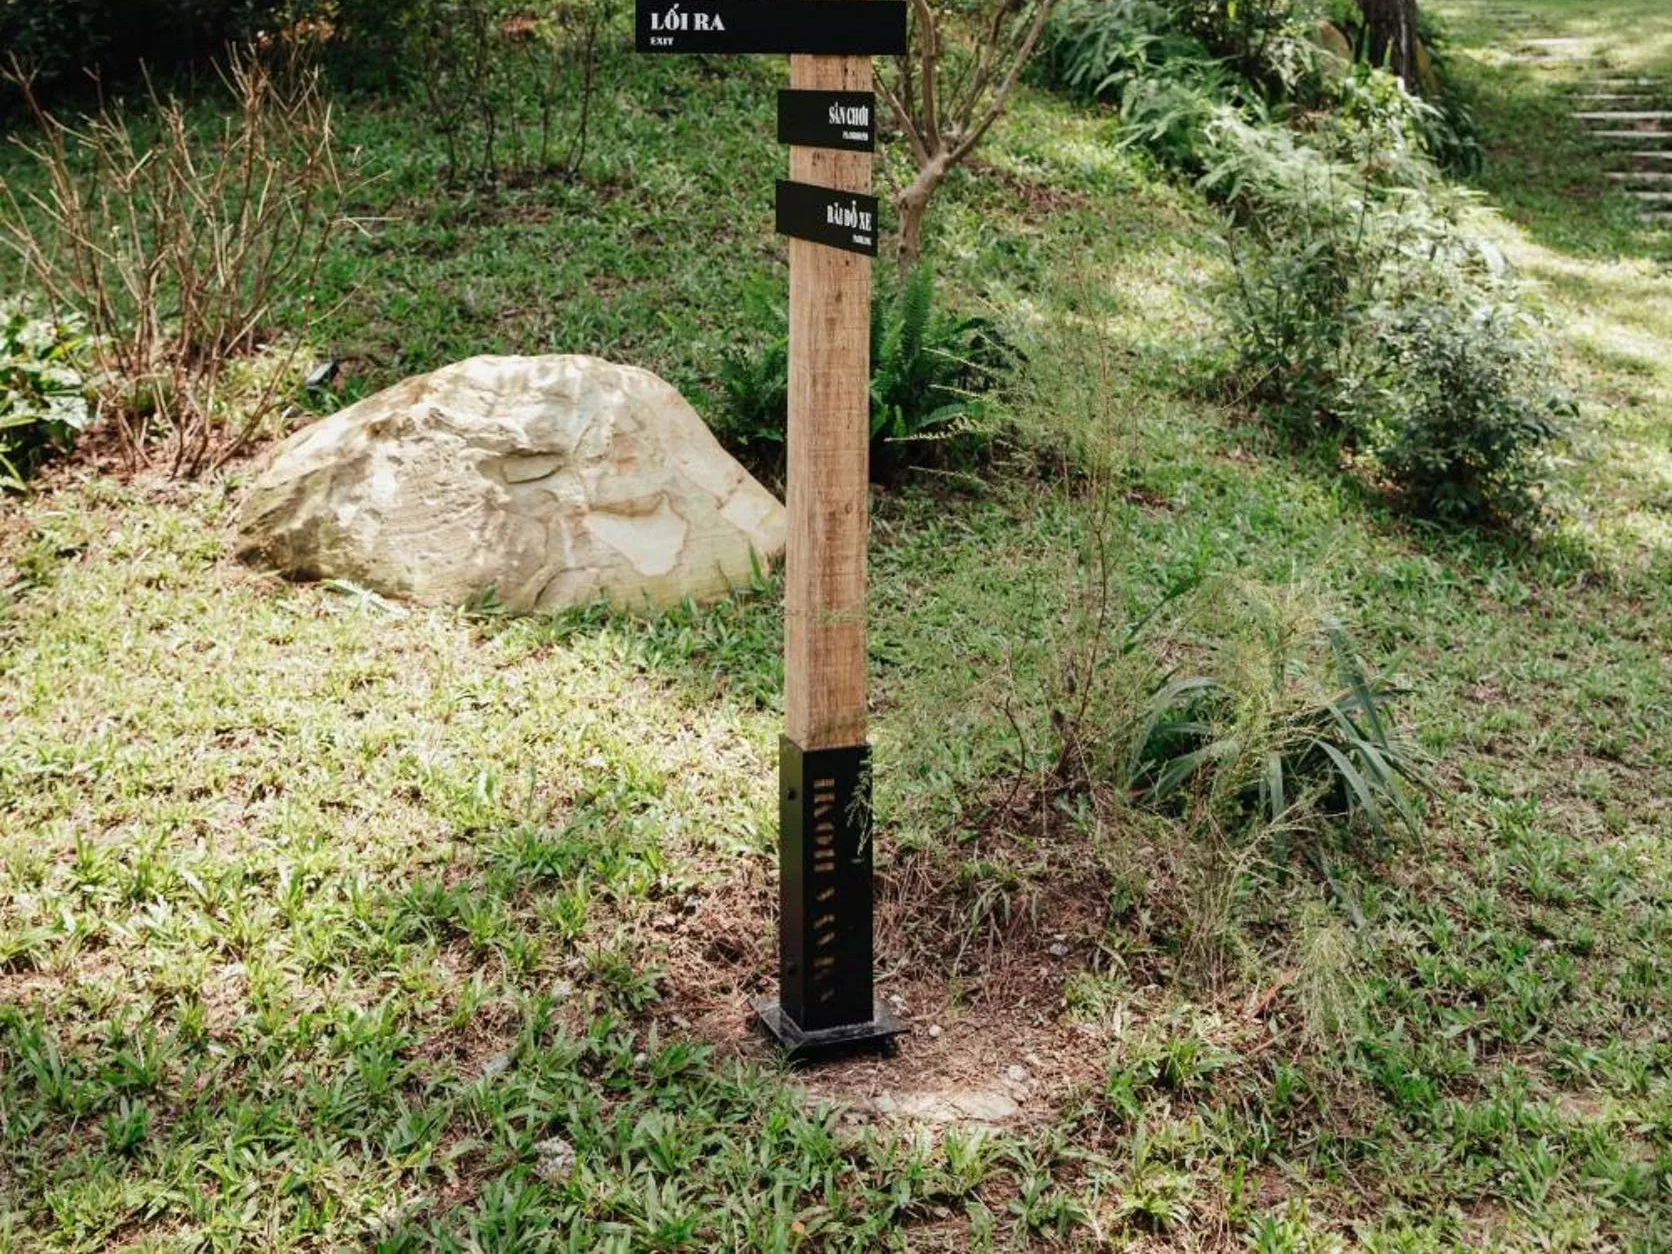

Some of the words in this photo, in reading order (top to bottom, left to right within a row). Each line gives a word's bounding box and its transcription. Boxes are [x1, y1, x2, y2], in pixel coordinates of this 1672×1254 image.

[651, 3, 688, 31] LỐI
[693, 13, 725, 31] RA
[650, 36, 674, 46] EXIT
